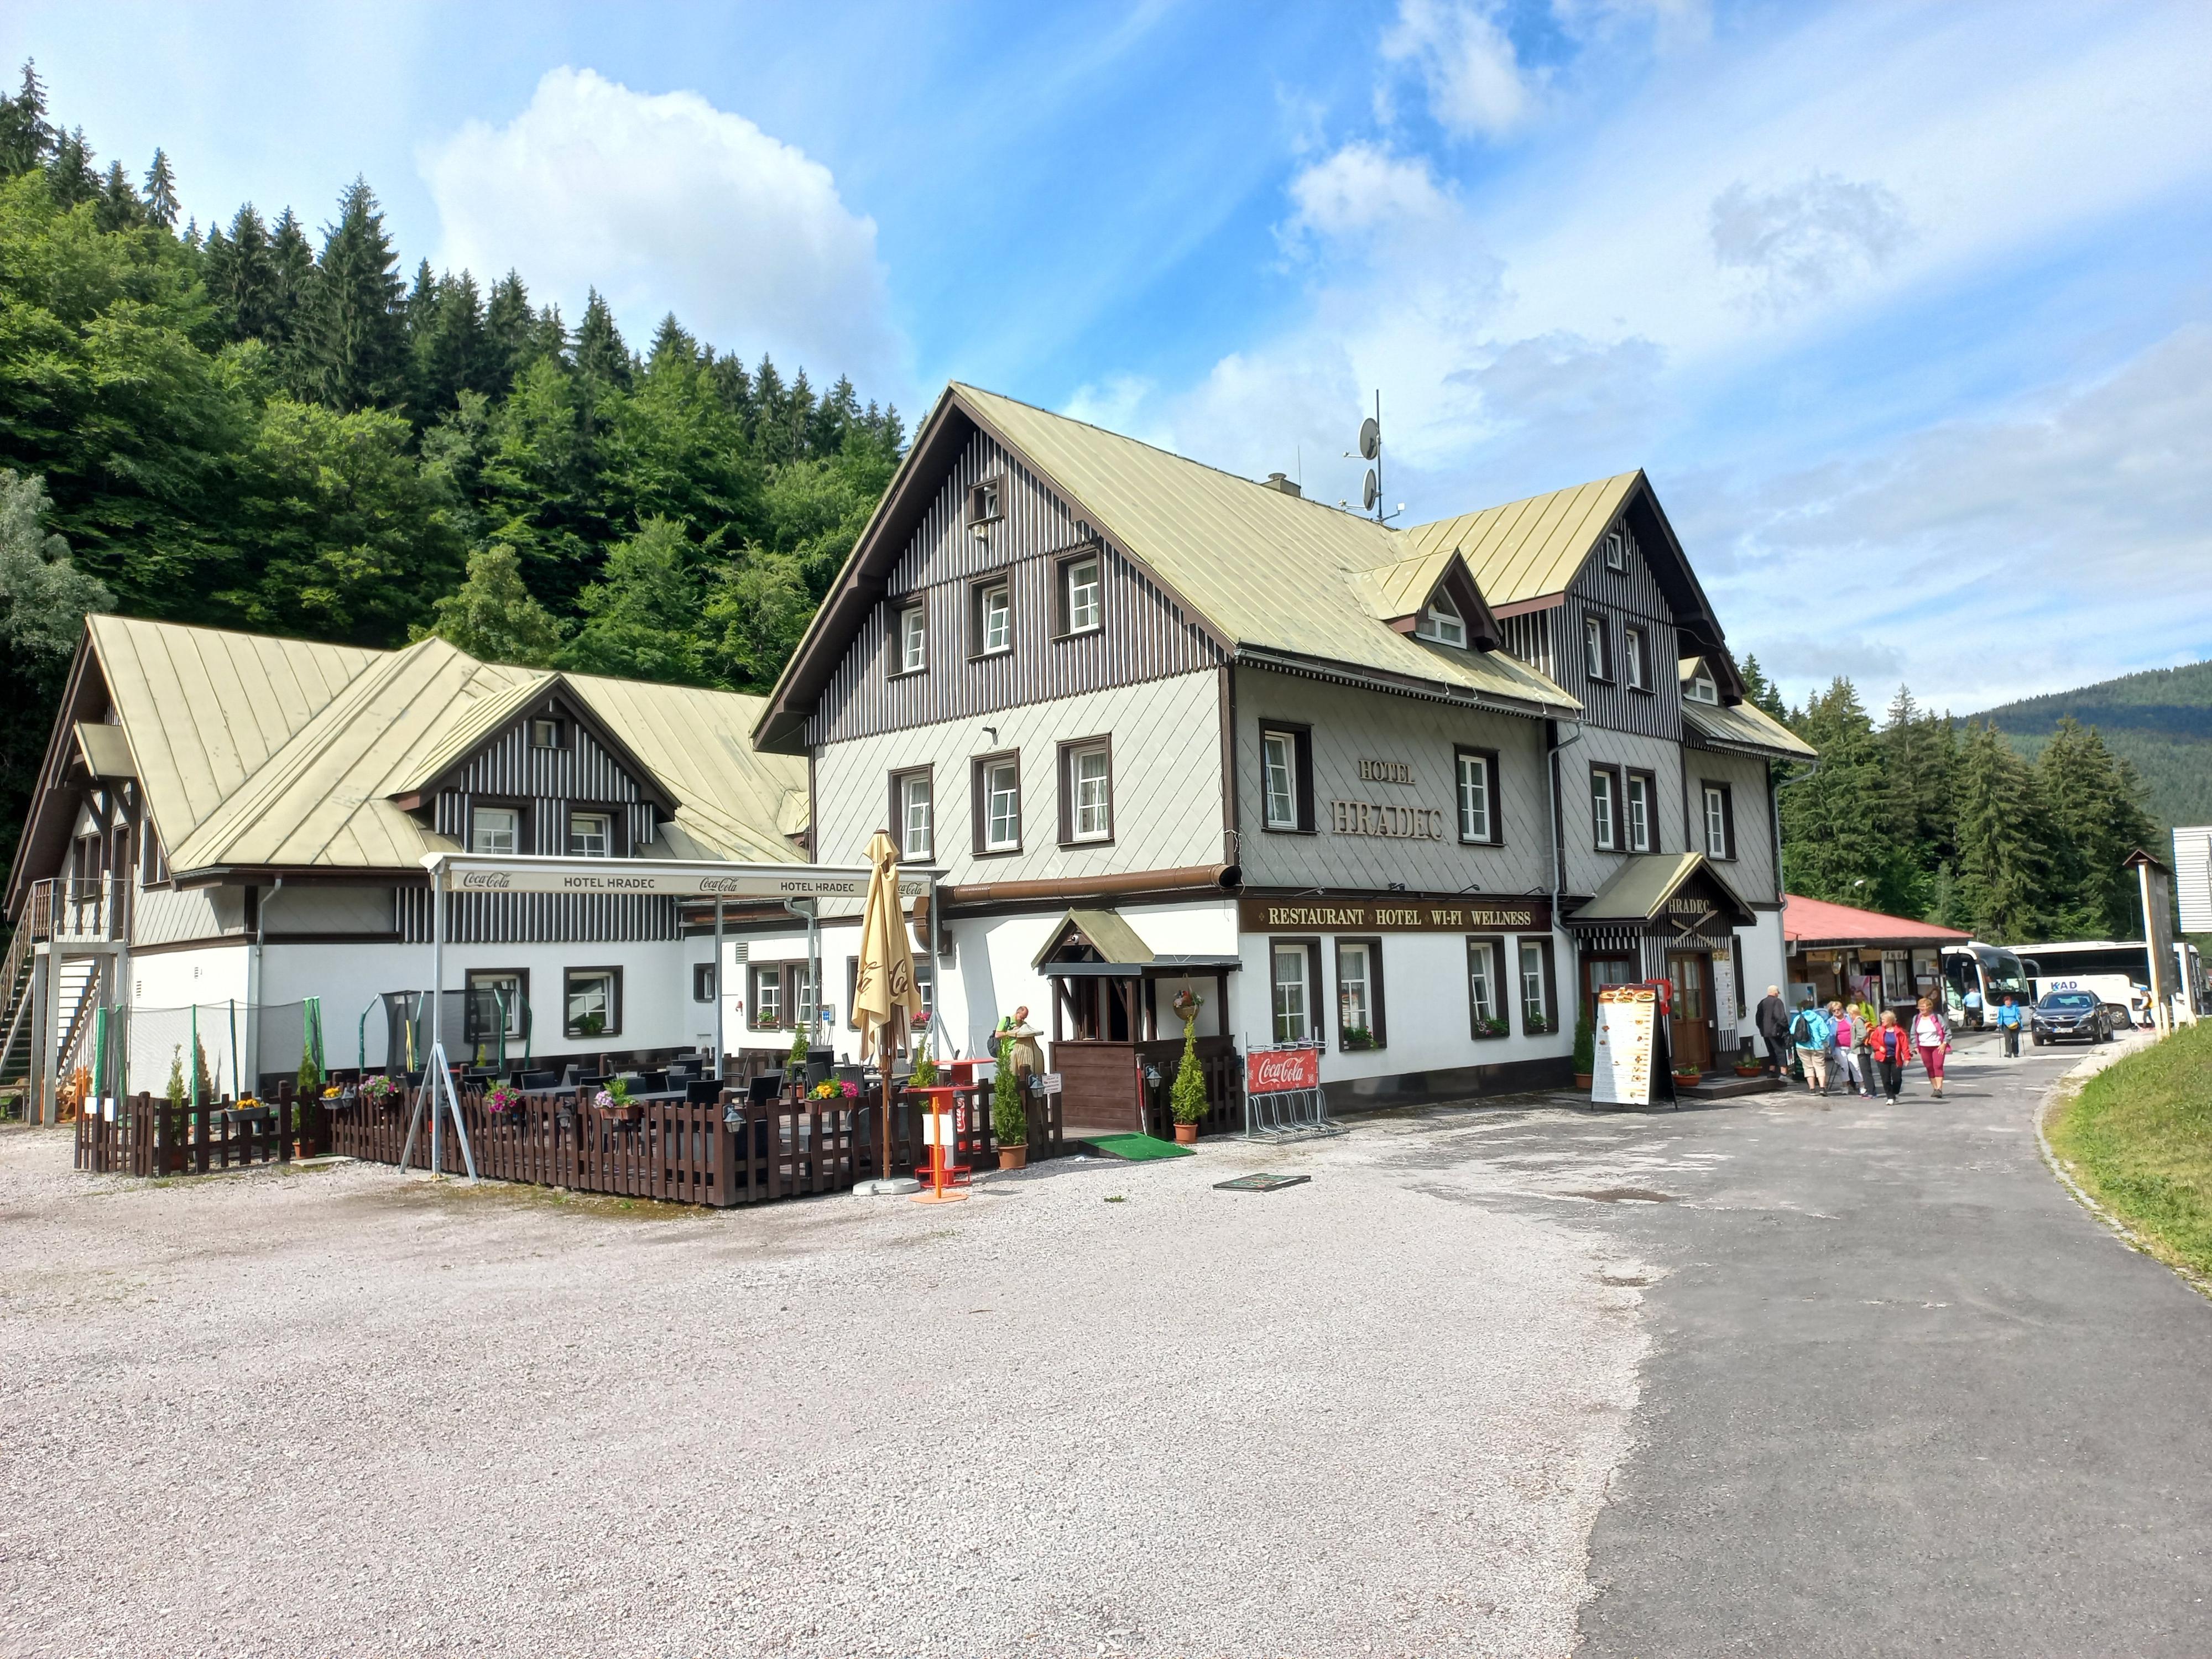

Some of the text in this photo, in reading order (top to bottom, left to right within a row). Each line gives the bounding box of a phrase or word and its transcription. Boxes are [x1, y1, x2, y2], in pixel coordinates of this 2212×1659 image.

[1359, 760, 1416, 784] HOTEL
[1331, 800, 1443, 841] HRADEC
[463, 872, 512, 888] Coca-Cola
[564, 877, 604, 888] HOTEL
[607, 878, 655, 889] HRADEC
[700, 877, 739, 891] Coca-Cola
[780, 881, 813, 891] HOTEL
[816, 882, 854, 893] HRADEC
[1268, 907, 1531, 926] RESTAURANT HOTEL WI-FI WELLNESS
[1668, 899, 1710, 914] HRADEC
[2051, 981, 2078, 990] KAD
[1258, 1056, 1306, 1085] Coca-Cola
